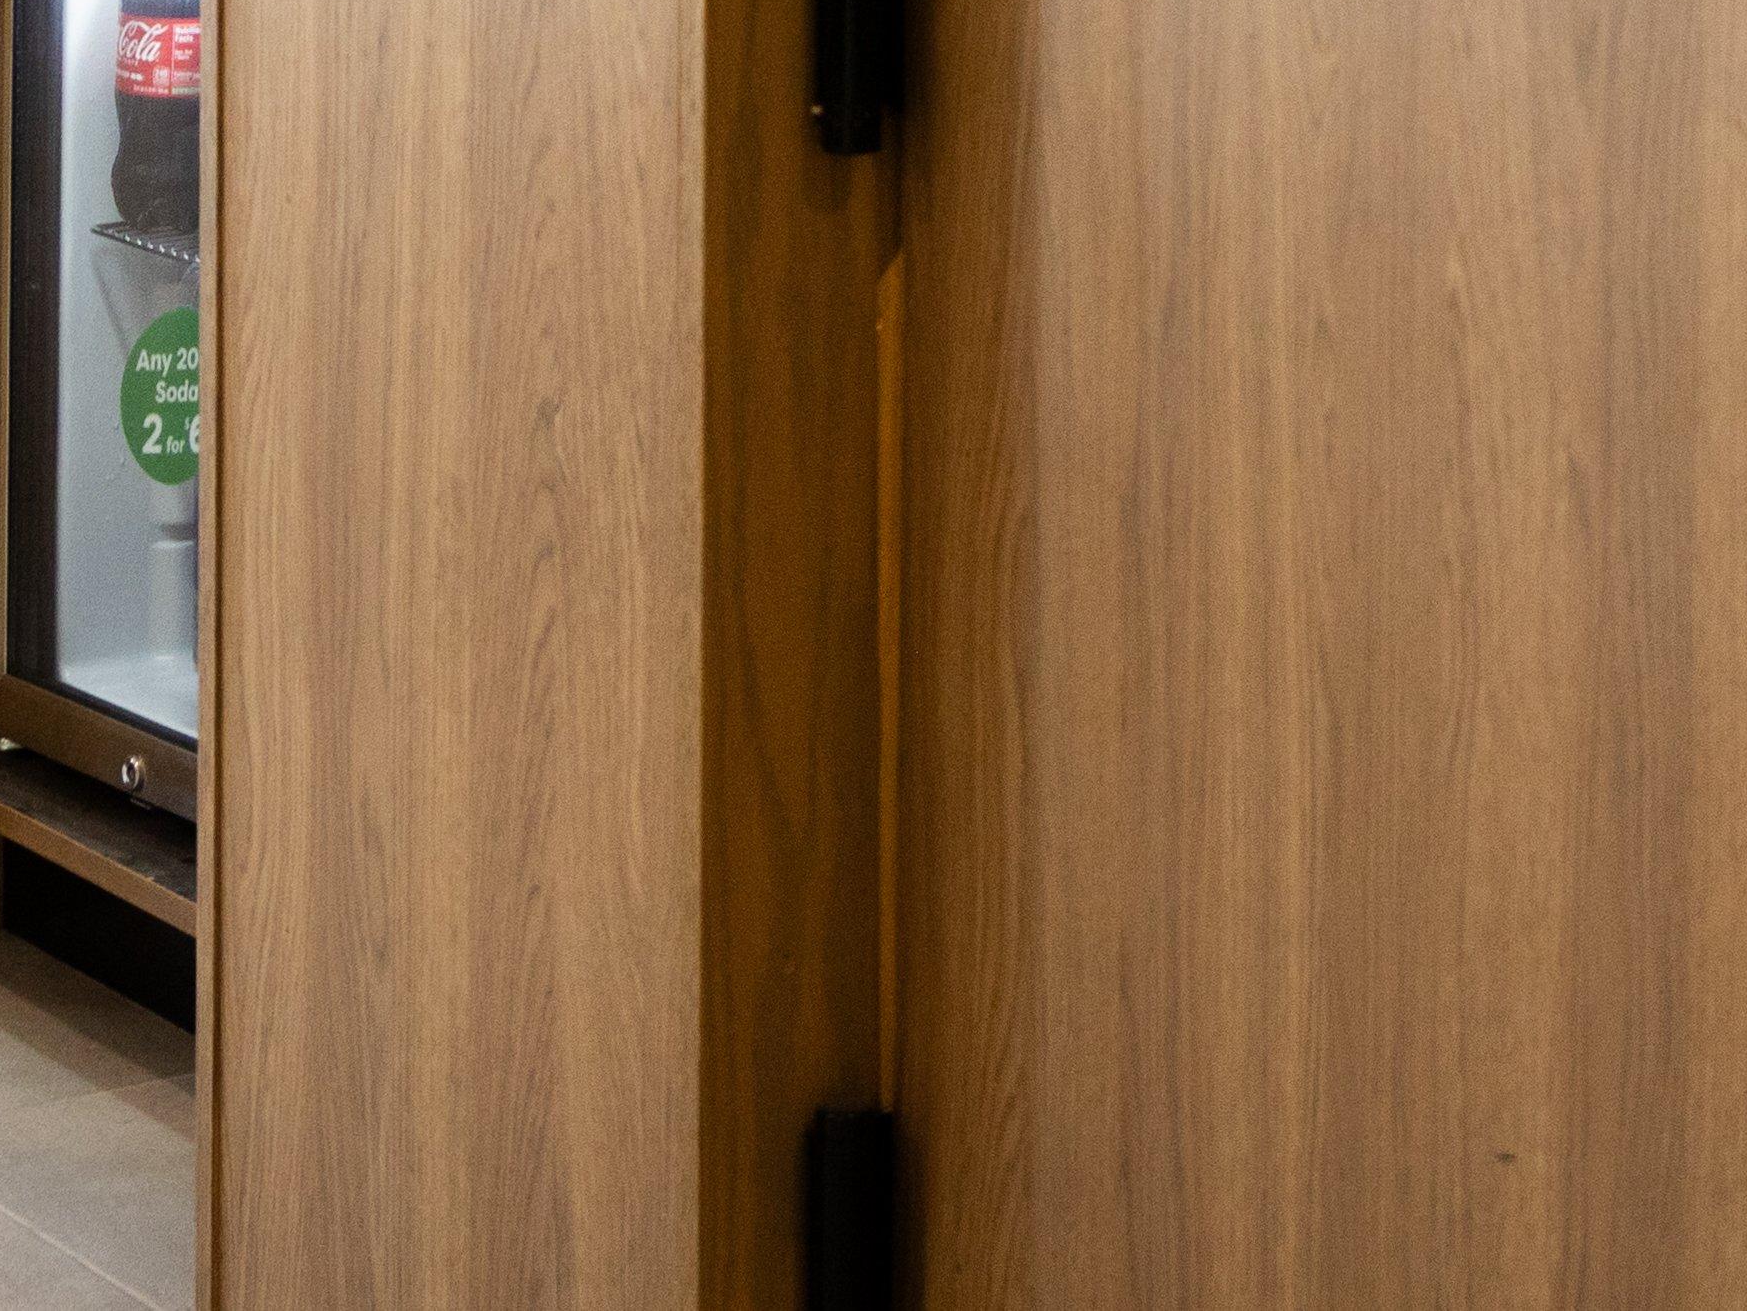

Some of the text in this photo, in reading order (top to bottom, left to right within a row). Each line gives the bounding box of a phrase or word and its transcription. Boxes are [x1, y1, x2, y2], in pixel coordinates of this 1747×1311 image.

[118, 19, 170, 64] Cola
[136, 349, 172, 377] Any
[141, 412, 185, 455] 2 for
